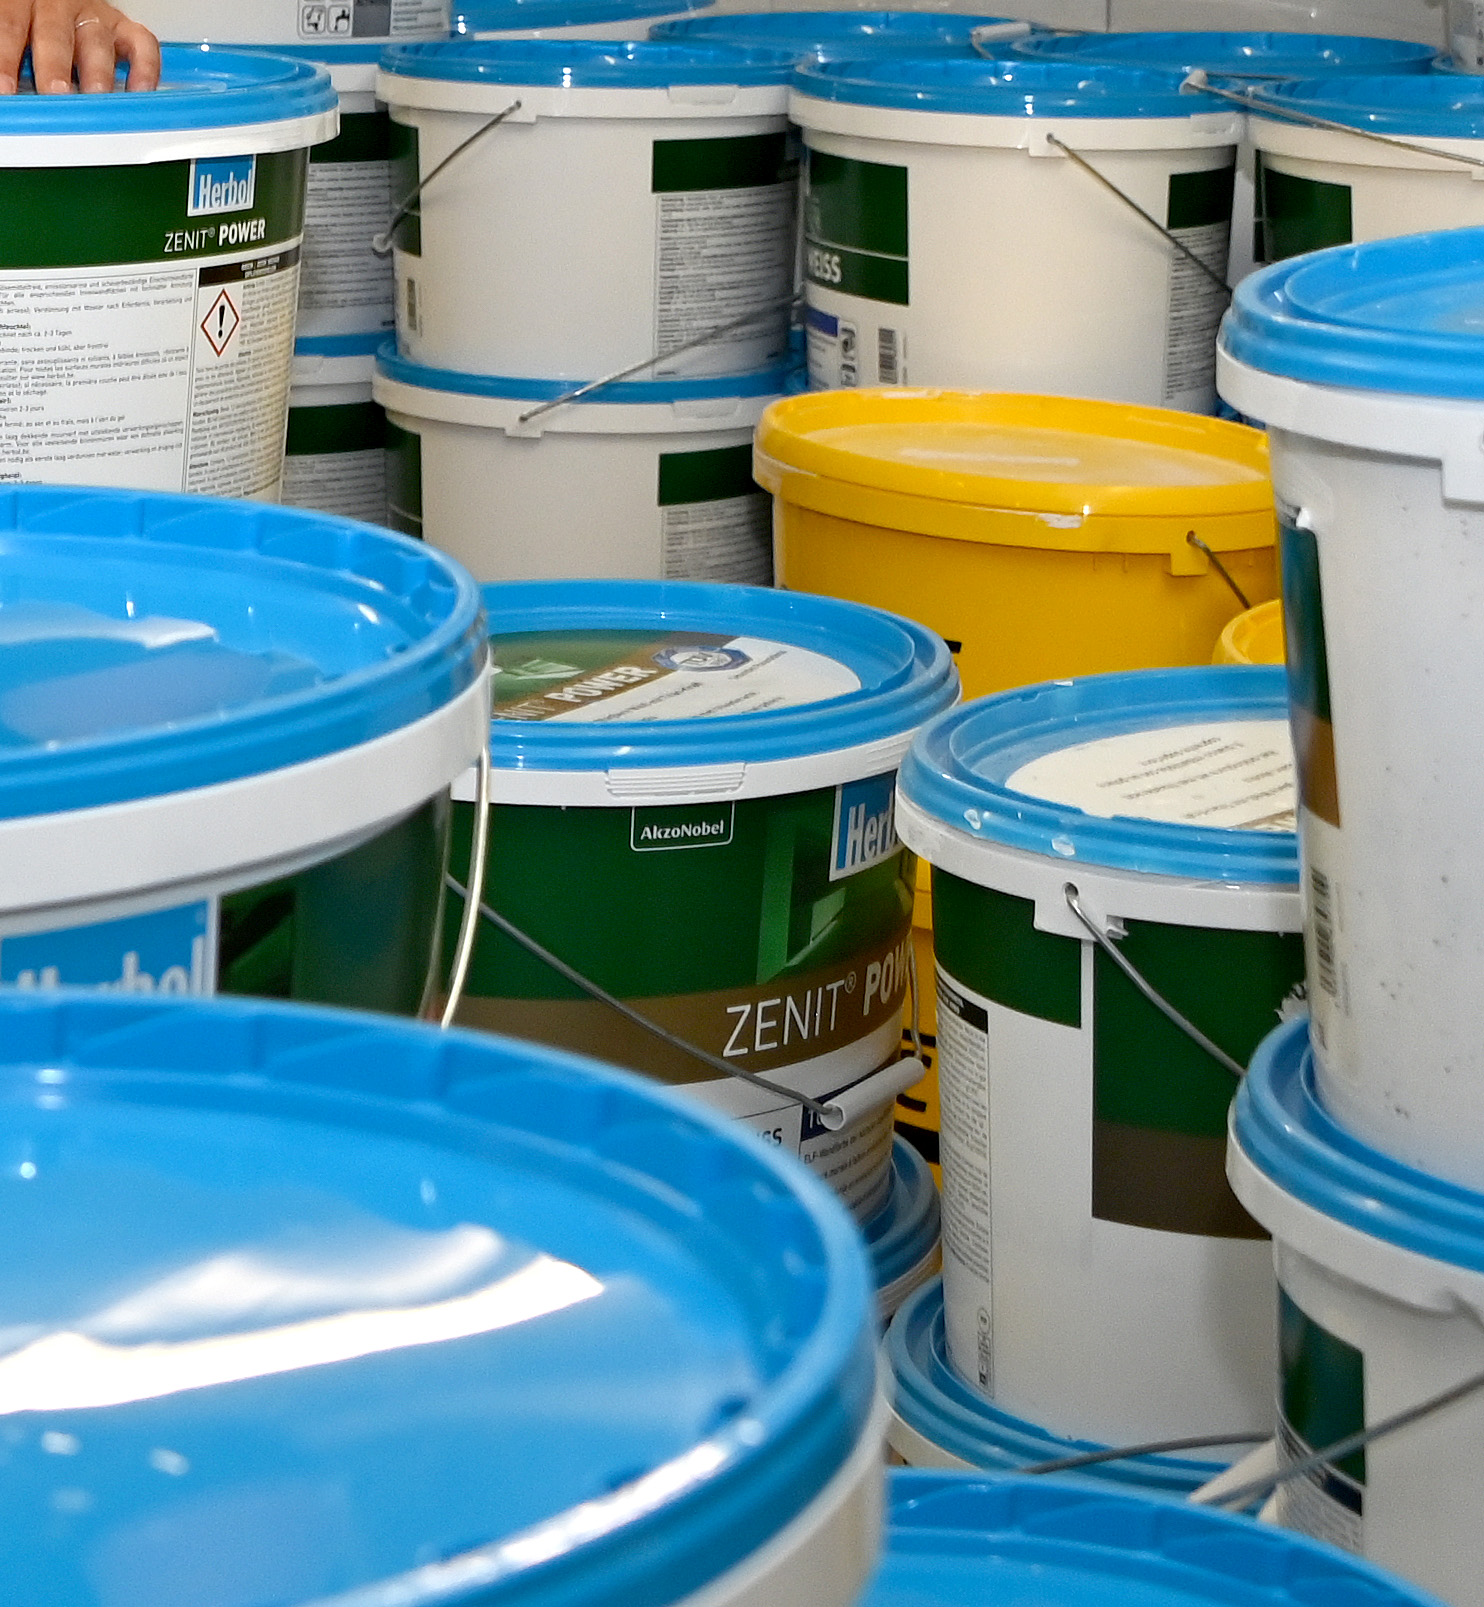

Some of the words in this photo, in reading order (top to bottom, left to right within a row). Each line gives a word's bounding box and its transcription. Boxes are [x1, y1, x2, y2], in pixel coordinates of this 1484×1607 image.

[199, 169, 252, 209] Herbol
[218, 217, 266, 246] POWER
[545, 666, 657, 703] POWER
[640, 819, 725, 841] AkzoNobel
